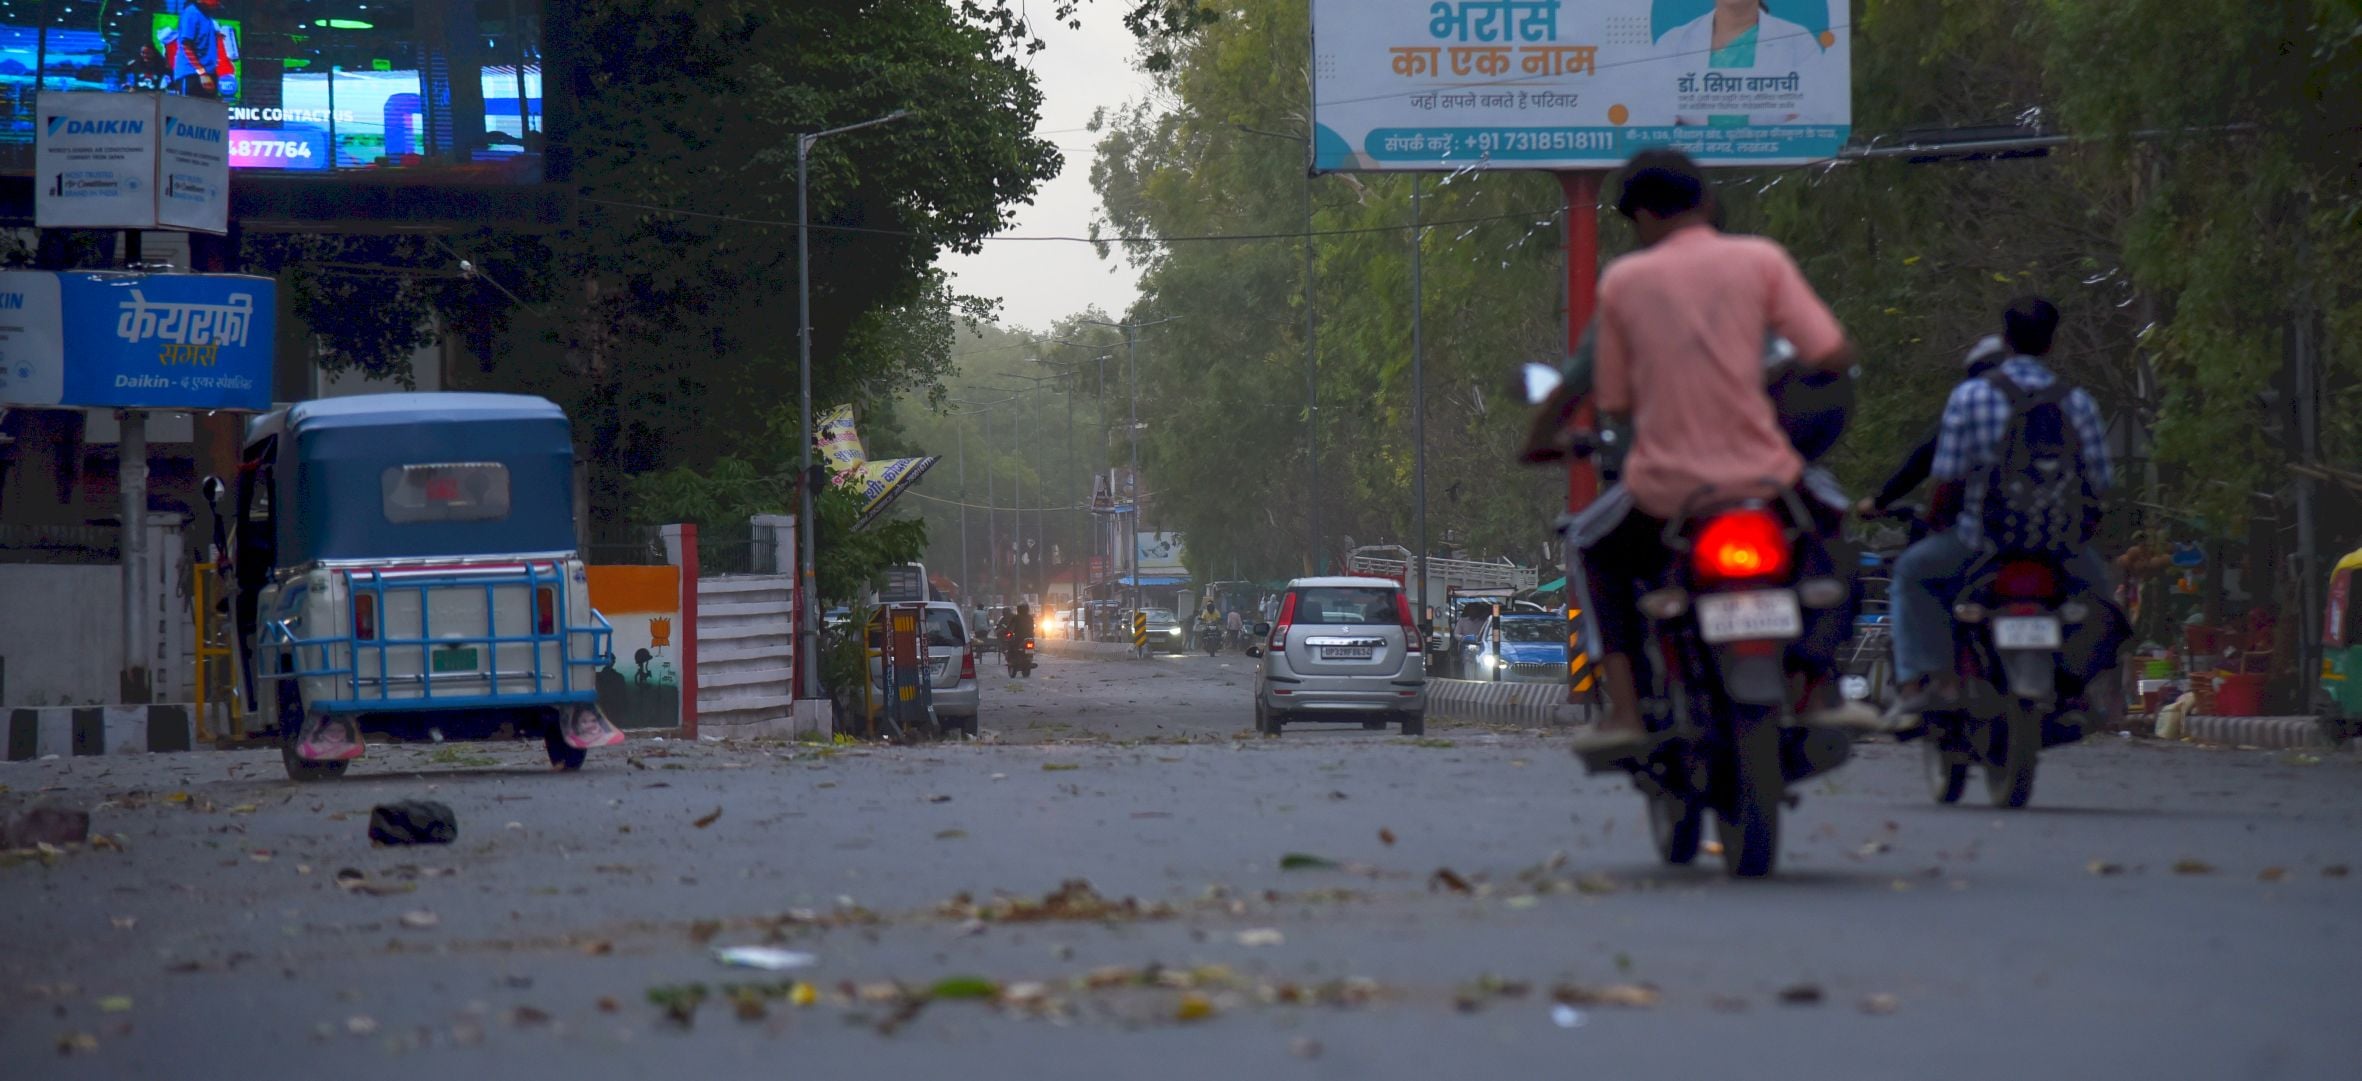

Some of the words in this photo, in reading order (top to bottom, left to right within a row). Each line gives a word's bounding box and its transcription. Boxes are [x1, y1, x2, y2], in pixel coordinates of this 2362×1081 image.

[1389, 46, 1441, 77] का
[1448, 46, 1512, 77] एक
[1519, 46, 1598, 76] नाम
[1678, 72, 1699, 93] डॉ.
[1704, 73, 1741, 93] सिप्रा
[1746, 72, 1799, 92] बागची
[1441, 91, 1476, 108] सपने
[1480, 91, 1514, 108] बनते
[1531, 90, 1578, 108] परिवार
[67, 120, 144, 134] DAIKIN
[176, 123, 221, 143] DAIKIN
[1385, 134, 1424, 151] संपर्क
[1428, 134, 1450, 152] करें
[1465, 133, 1499, 150] +91
[1504, 132, 1613, 150] 7318518111
[117, 289, 253, 347] केयरफ्री
[159, 337, 220, 366] समर्स
[115, 374, 169, 387] Daikin
